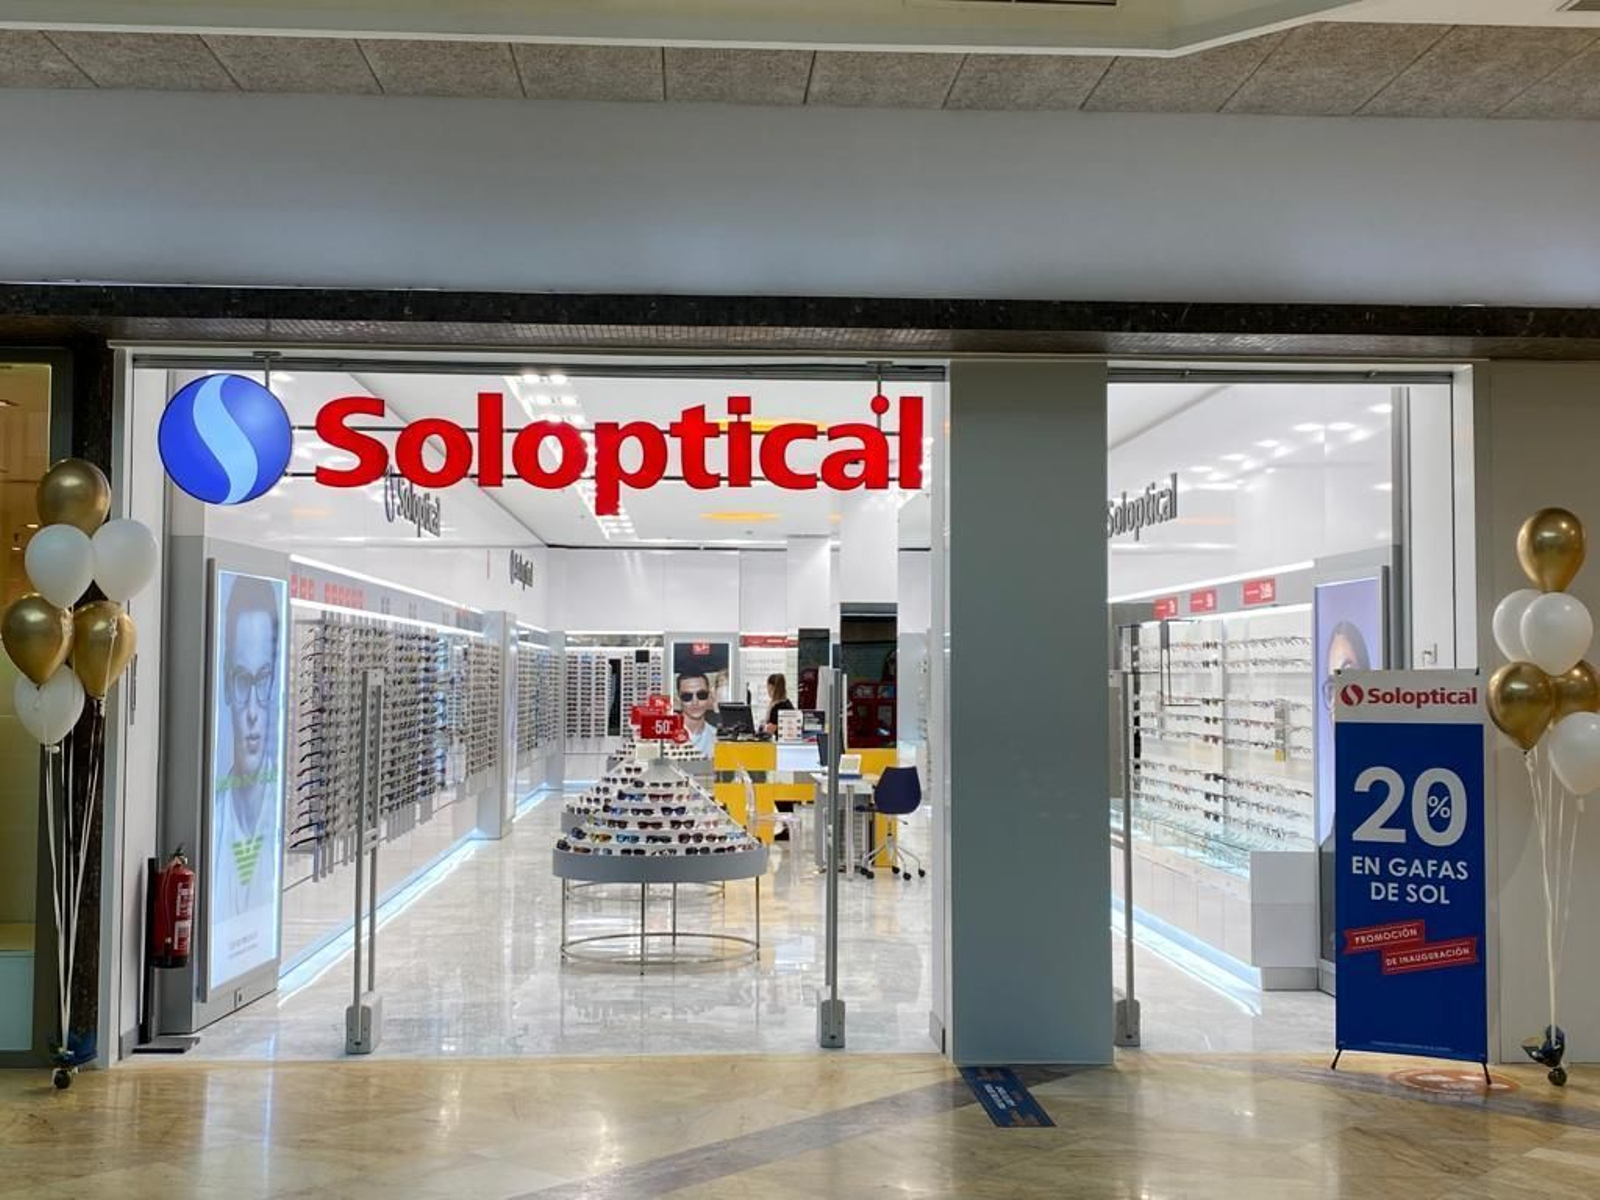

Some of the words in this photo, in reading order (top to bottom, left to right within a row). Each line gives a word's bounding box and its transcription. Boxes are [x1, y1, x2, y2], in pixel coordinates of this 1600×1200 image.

[315, 392, 924, 515] Soloptical
[1107, 472, 1177, 541] Soloptical
[1367, 686, 1478, 709] Soloptical
[1352, 856, 1380, 875] EN
[1388, 858, 1469, 880] GAFAS
[1370, 882, 1399, 901] DE
[1406, 883, 1450, 904] SOL
[1354, 928, 1418, 945] PROMOCIÓN
[1386, 957, 1398, 967] DE
[1399, 946, 1470, 963] INAUGURACIÓN
